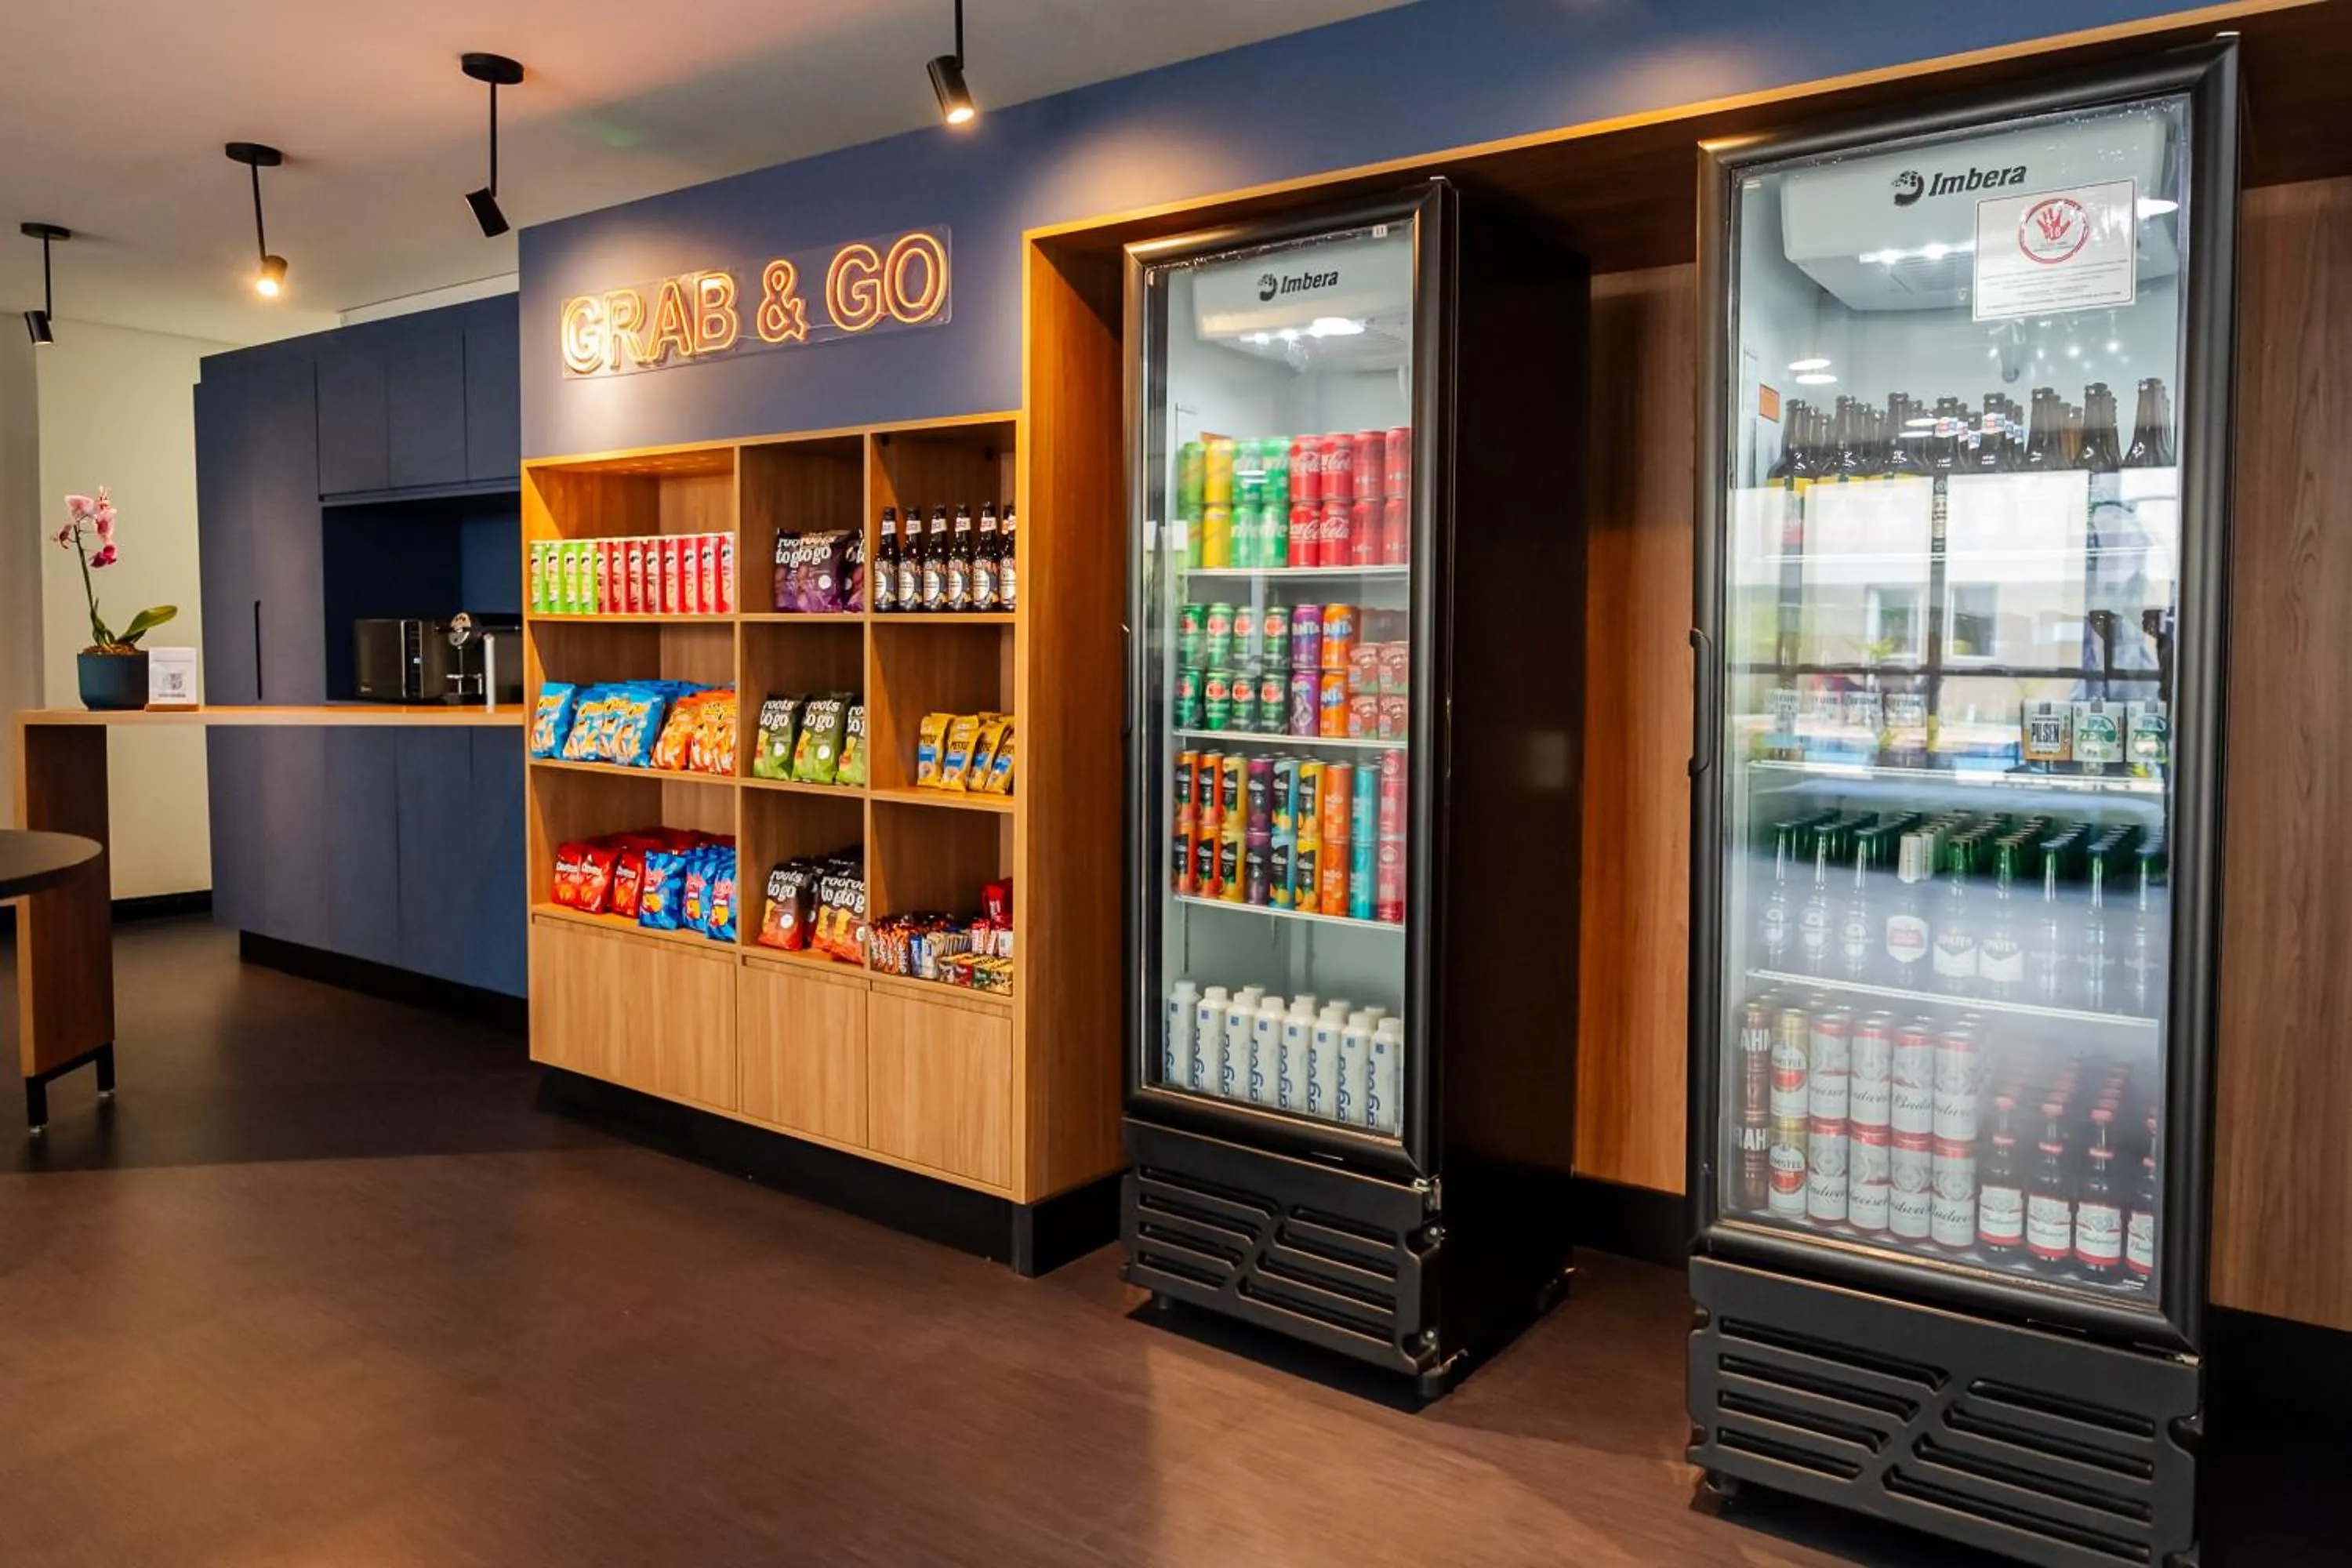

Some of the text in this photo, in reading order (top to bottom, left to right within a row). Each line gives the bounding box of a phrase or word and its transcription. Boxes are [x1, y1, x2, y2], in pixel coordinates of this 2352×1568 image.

[1929, 165, 2027, 197] Imbera
[1280, 270, 1339, 294] Imbera
[561, 232, 948, 373] GRAB & GO
[812, 544, 832, 564] go
[761, 699, 794, 715] roots
[806, 699, 841, 715] roots
[771, 713, 789, 731] go
[815, 714, 835, 732] go
[2087, 718, 2109, 729] IPA
[2031, 723, 2060, 743] PILSEN
[770, 870, 803, 884] roots
[821, 877, 846, 887] roo
[778, 884, 797, 902] go
